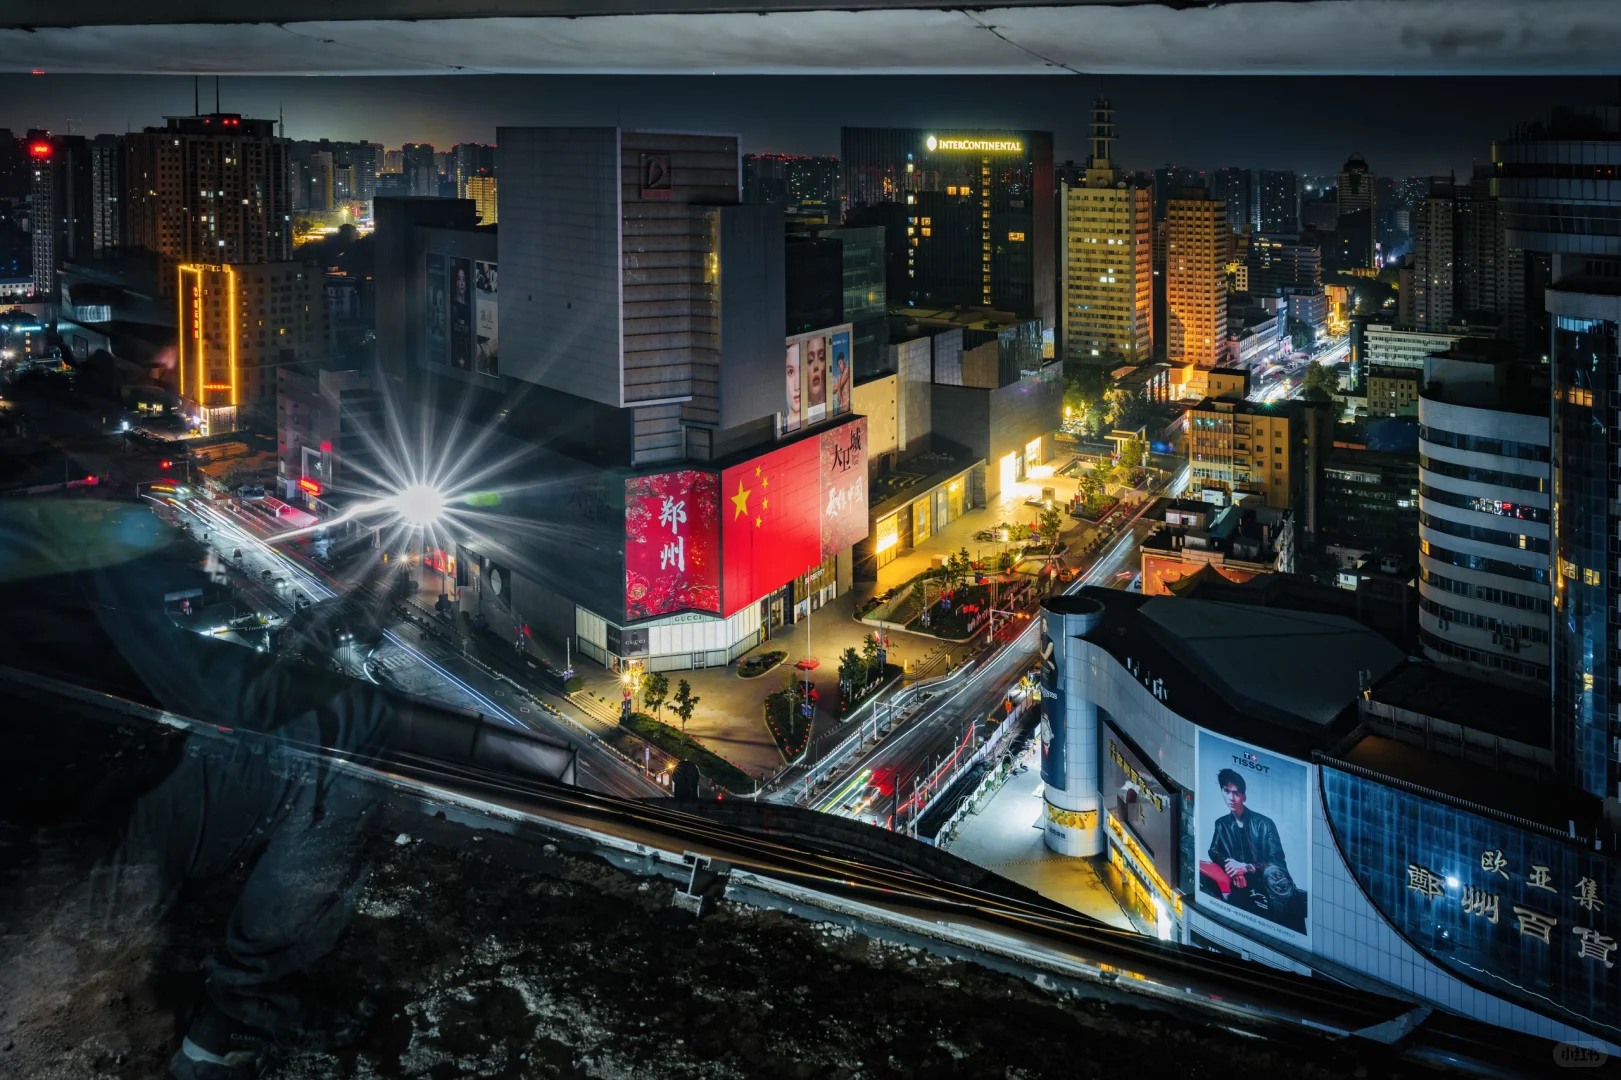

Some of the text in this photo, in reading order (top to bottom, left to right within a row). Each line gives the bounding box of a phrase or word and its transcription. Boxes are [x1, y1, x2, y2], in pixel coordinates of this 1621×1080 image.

[939, 139, 1021, 151] INTERCONTINENTAL
[832, 427, 861, 473] 大卫城
[658, 495, 687, 572] 郑州
[674, 614, 702, 622] GUCCI
[1231, 755, 1270, 774] TISSOT
[1481, 849, 1605, 912] 欧亚集
